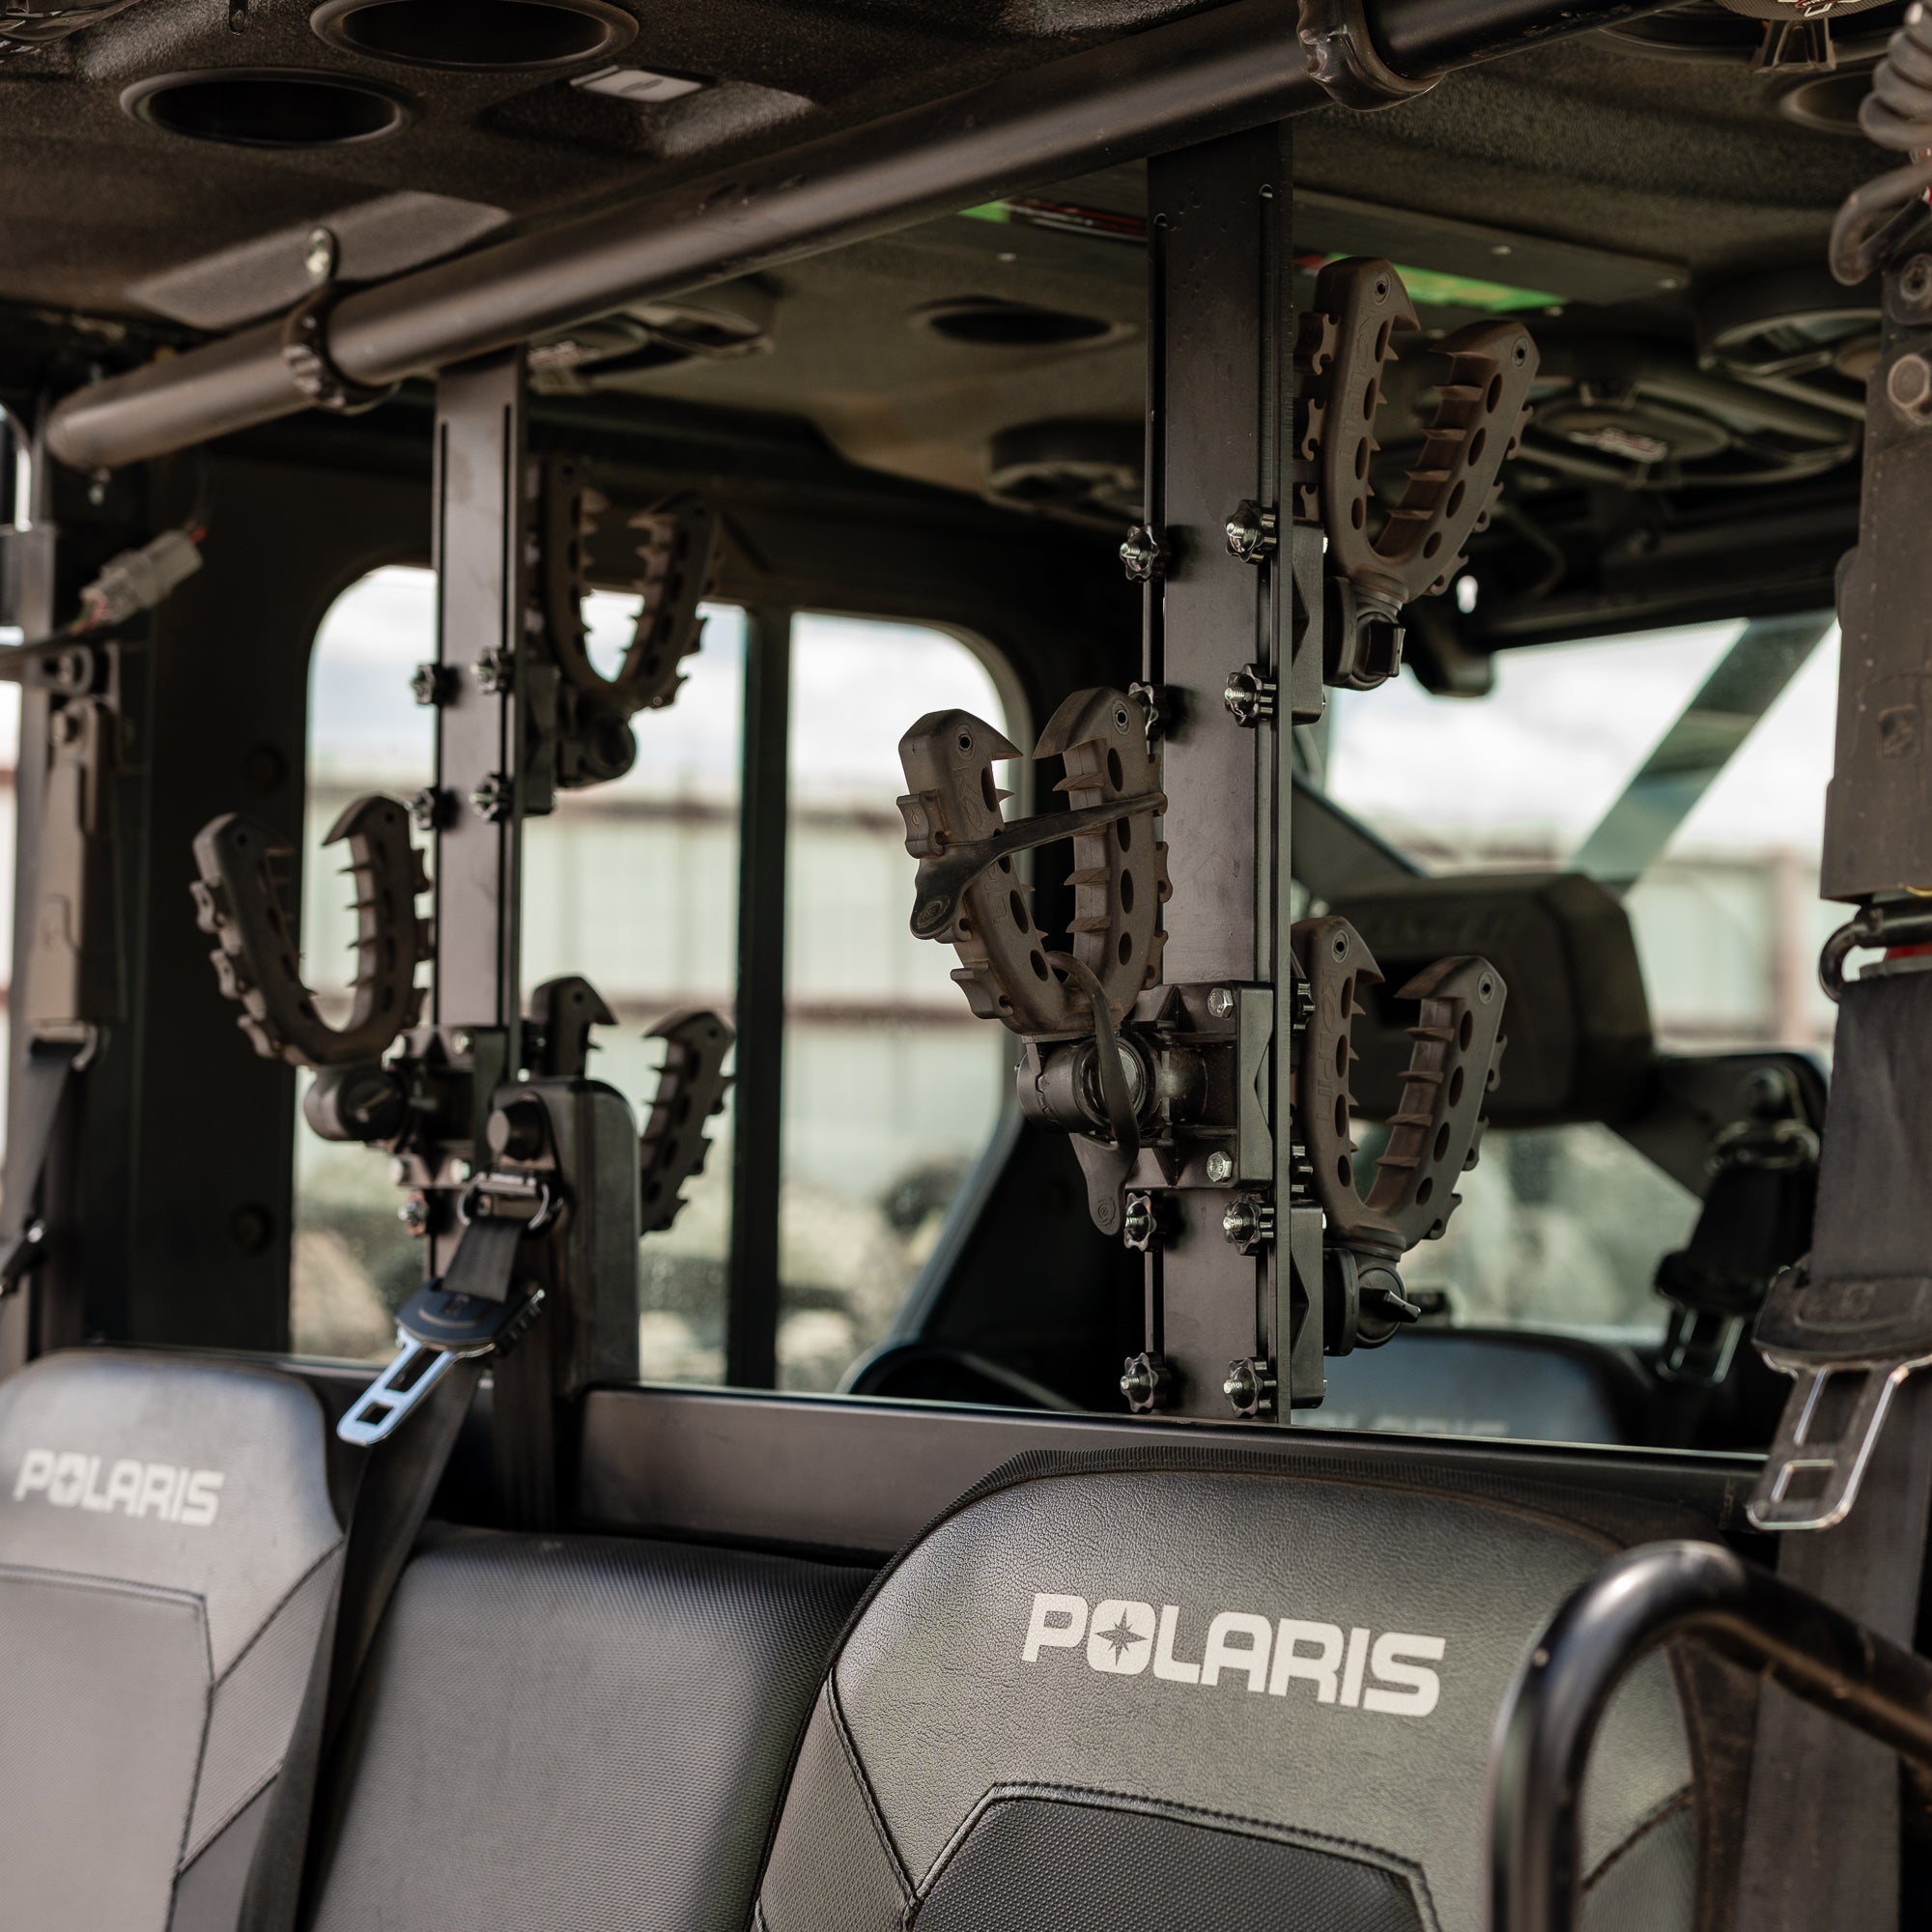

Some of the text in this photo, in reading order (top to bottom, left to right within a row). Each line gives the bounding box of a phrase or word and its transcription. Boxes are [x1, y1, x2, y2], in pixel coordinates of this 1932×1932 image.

[1317, 968, 1337, 1122] KOLPIN
[14, 1449, 225, 1526] POLARIS
[1021, 1593, 1446, 1717] POLARIS
